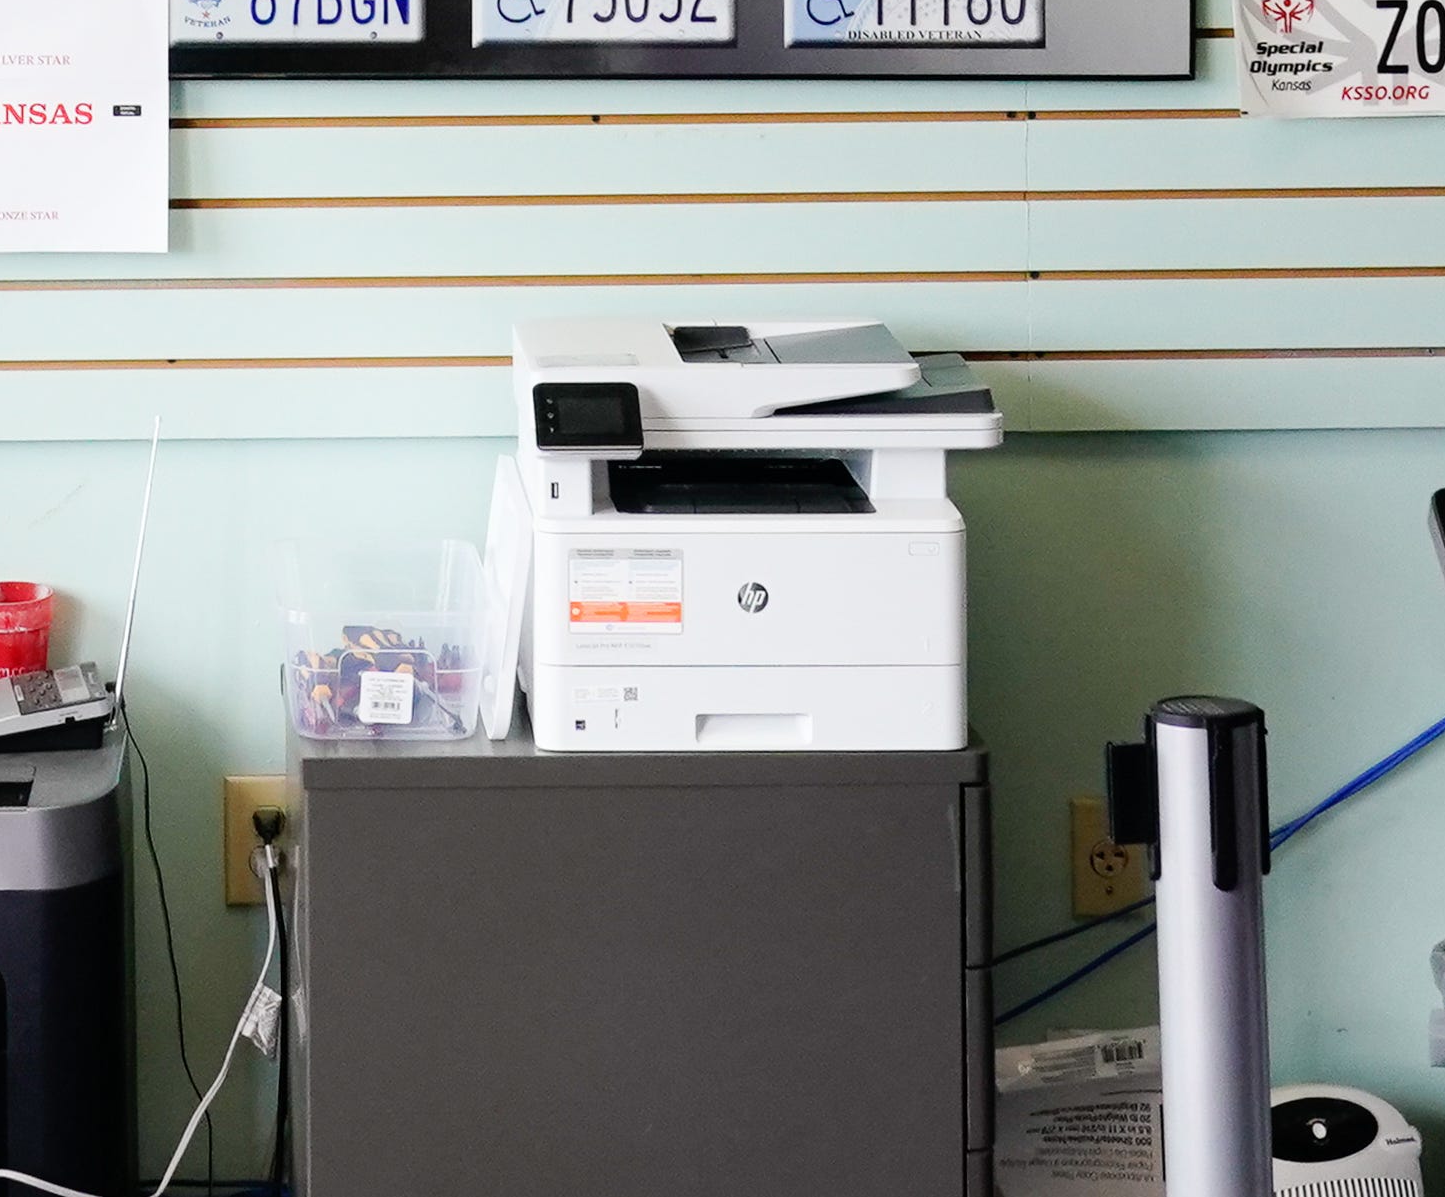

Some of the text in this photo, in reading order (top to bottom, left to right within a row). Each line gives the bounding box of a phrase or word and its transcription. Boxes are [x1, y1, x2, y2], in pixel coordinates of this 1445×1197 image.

[848, 30, 983, 40] DISABLED VETERAN
[1256, 42, 1324, 56] Special
[37, 55, 71, 67] STAR
[1250, 60, 1333, 75] Olympics
[1272, 79, 1312, 91] Kansas
[1341, 86, 1430, 101] KSSO.ORG
[31, 211, 59, 222] STAR
[743, 582, 766, 613] hp
